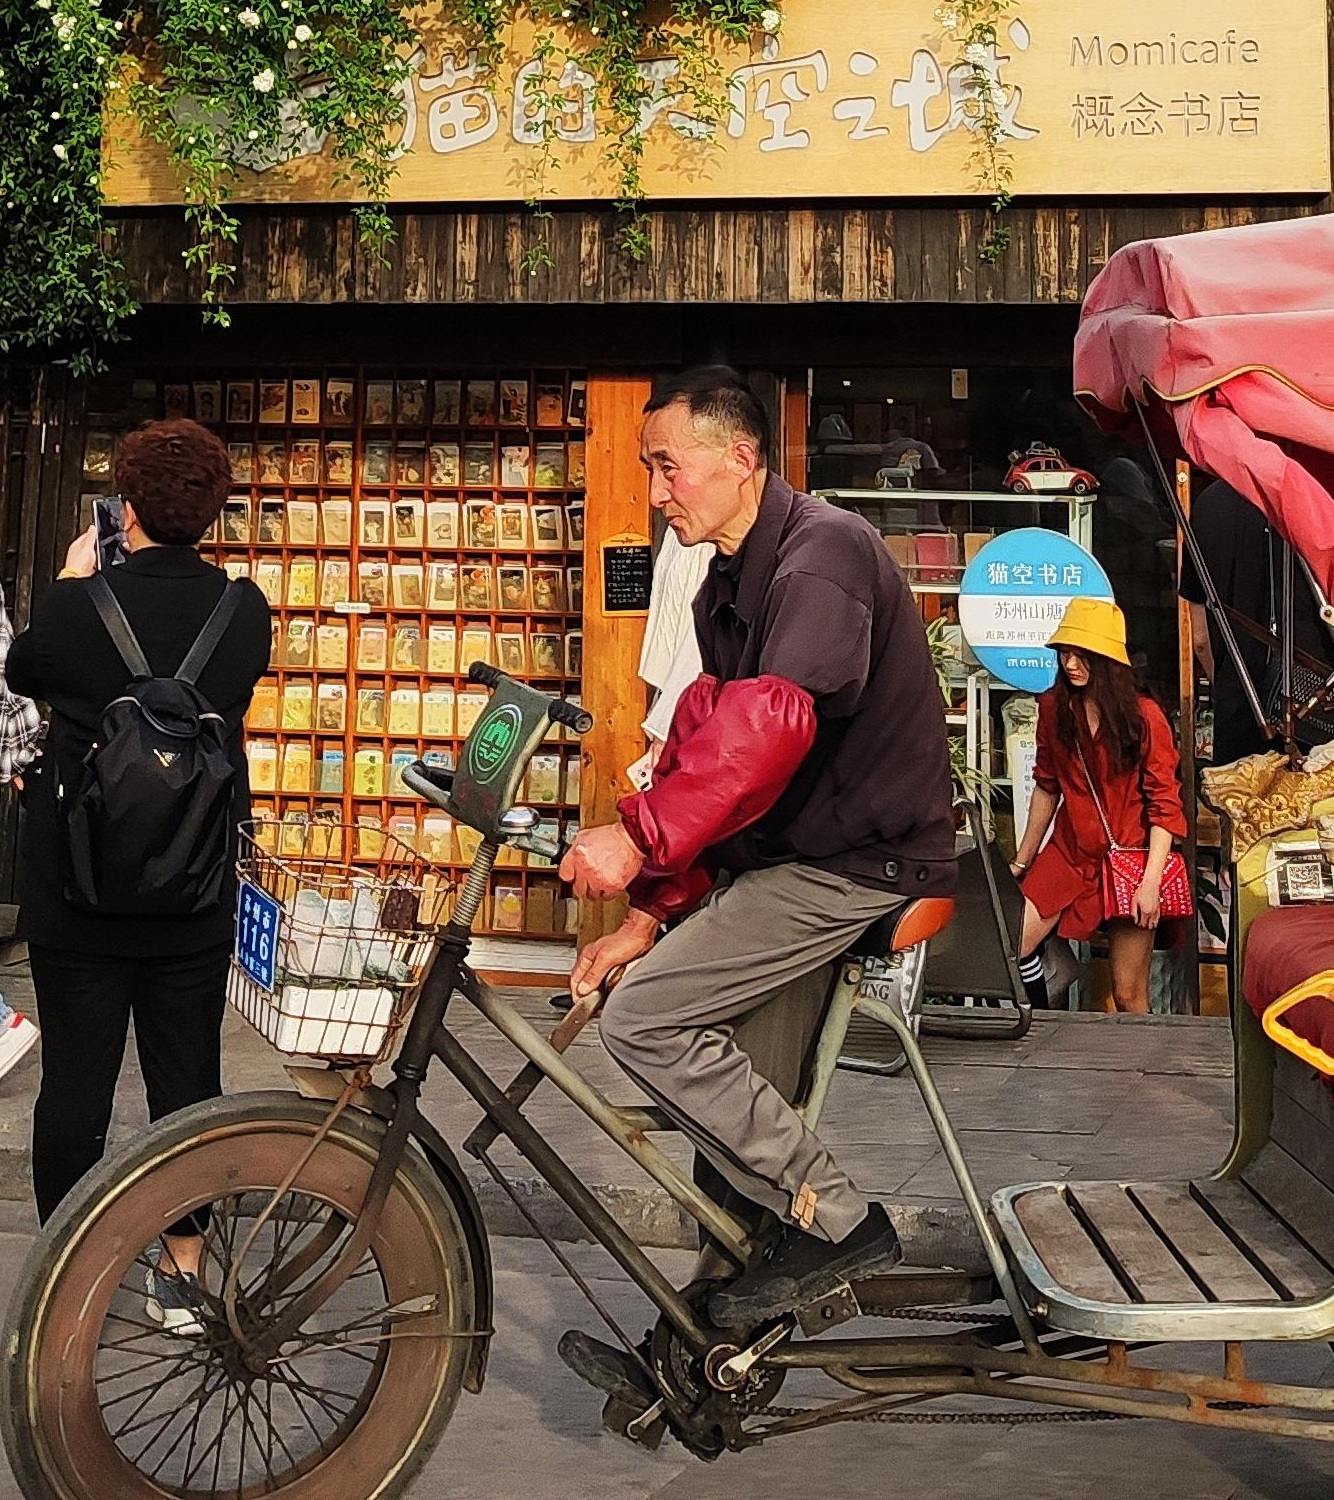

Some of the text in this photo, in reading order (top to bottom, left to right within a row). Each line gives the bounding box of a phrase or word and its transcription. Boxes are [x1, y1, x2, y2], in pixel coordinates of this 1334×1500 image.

[1070, 29, 1259, 67] Momicafe
[1071, 91, 1261, 138] 概念书店
[987, 562, 1083, 586] 猫空书店
[994, 601, 1067, 621] 苏州山塘
[985, 629, 1051, 641] 距离苏州平江
[1007, 656, 1056, 668] momic
[243, 916, 269, 961] 116
